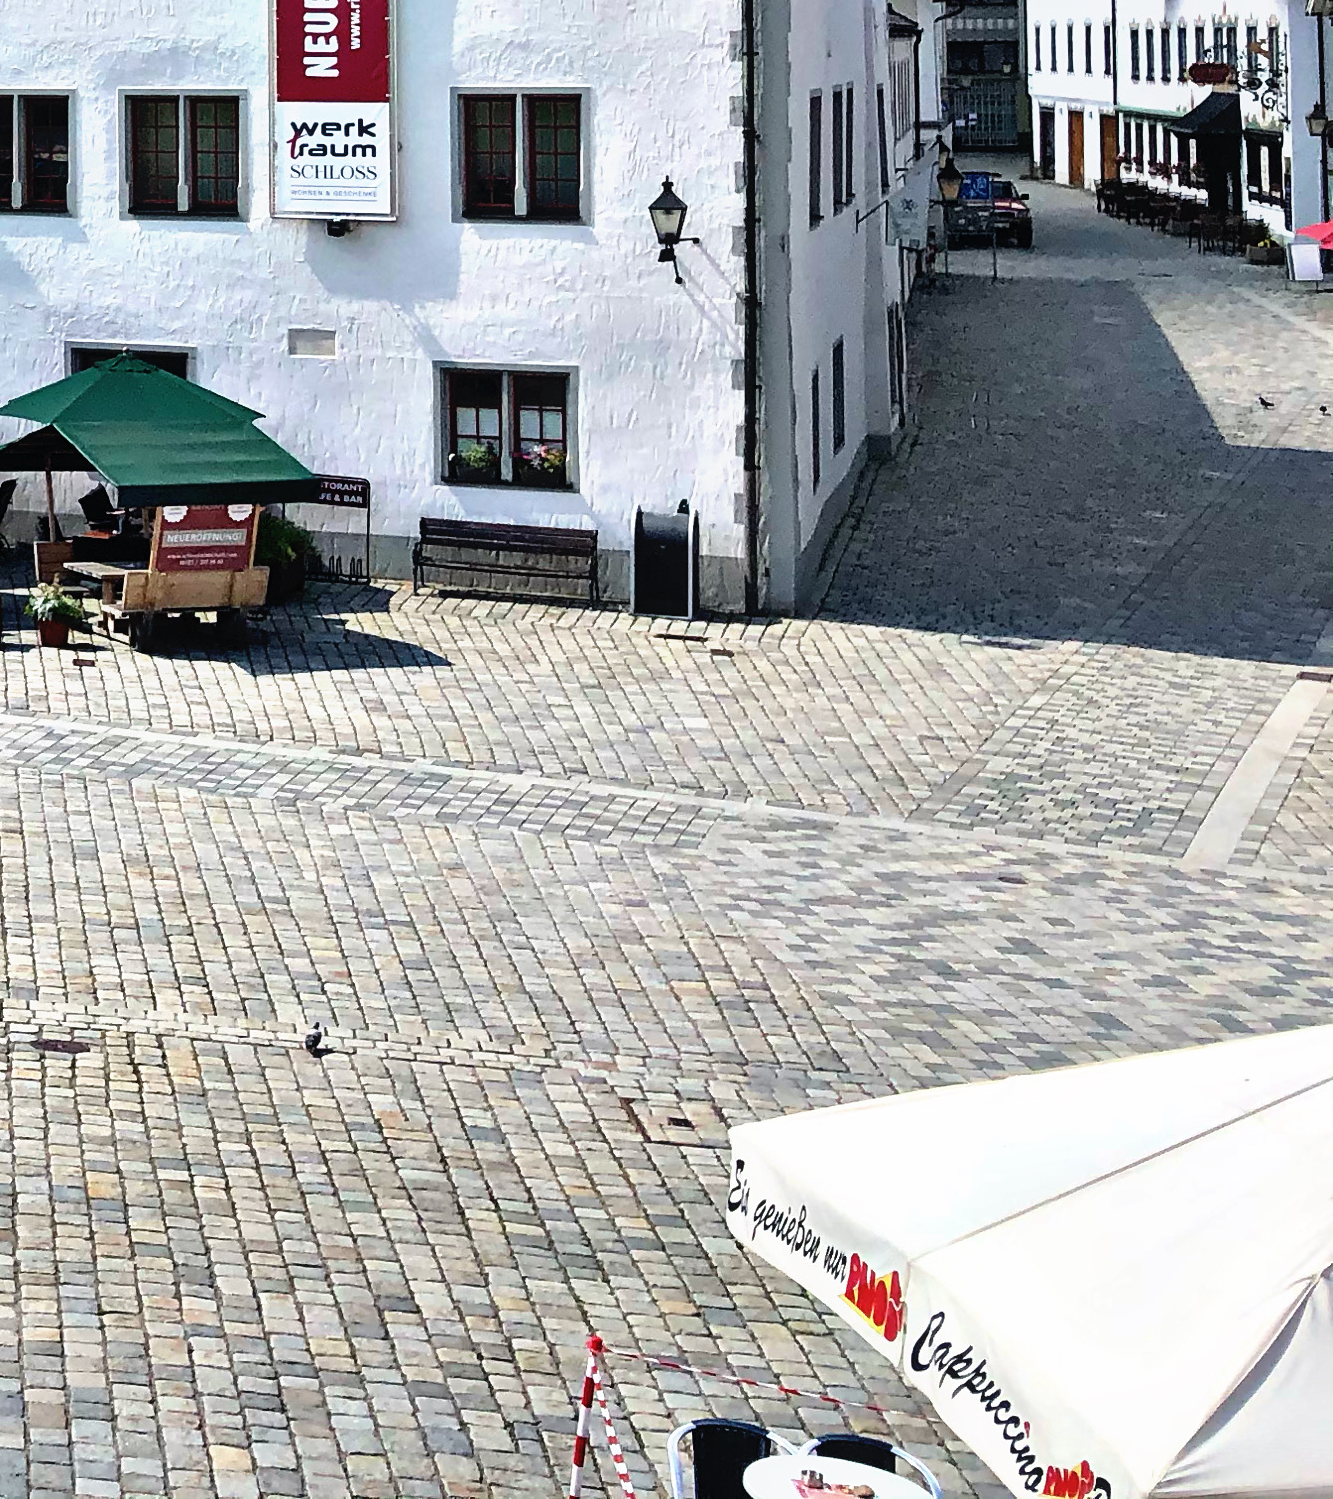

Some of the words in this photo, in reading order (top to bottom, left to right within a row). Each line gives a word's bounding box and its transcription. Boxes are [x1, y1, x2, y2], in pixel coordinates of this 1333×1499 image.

[290, 118, 377, 138] werk
[290, 164, 377, 181] SCHLOSS
[333, 190, 377, 198] GESCHENKE
[321, 481, 363, 491] TORANT
[343, 495, 363, 503] BAR
[752, 1199, 821, 1264] genießen
[824, 1245, 848, 1283] nur
[911, 1312, 1044, 1493] Cappuccino
